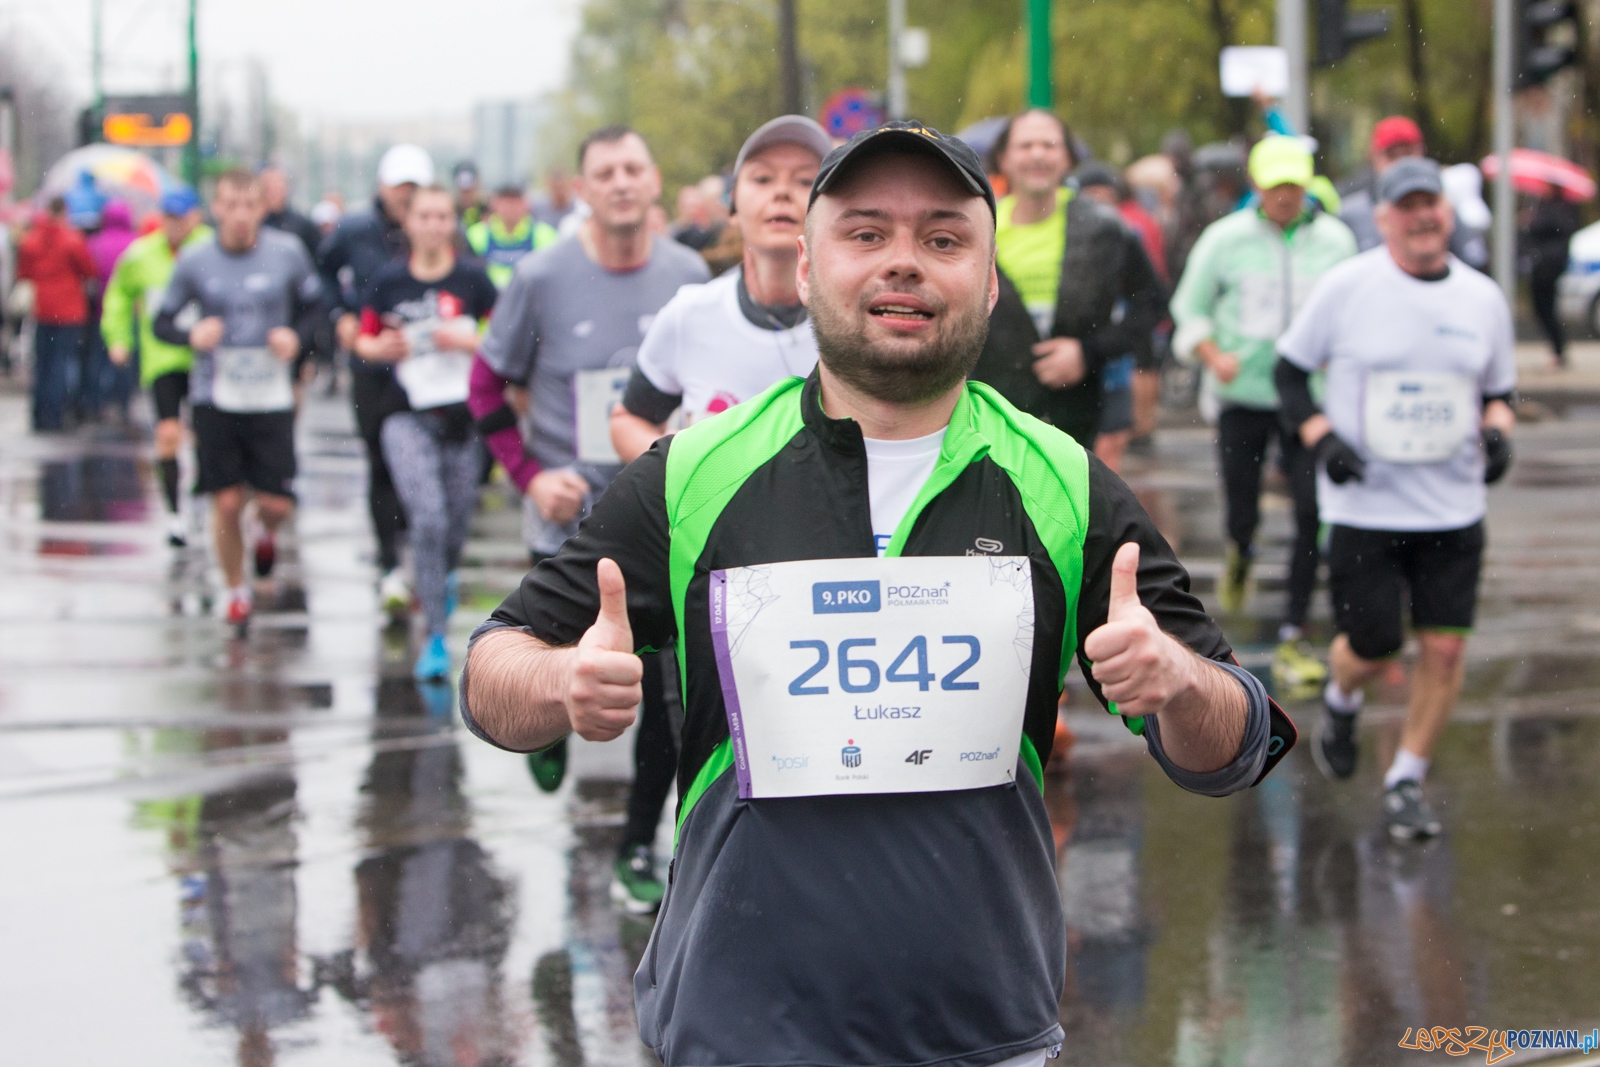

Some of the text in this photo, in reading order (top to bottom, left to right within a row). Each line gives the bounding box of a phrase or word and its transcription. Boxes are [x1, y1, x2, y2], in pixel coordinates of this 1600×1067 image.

[837, 589, 872, 605] PKO
[788, 635, 981, 696] 2642
[854, 704, 922, 720] Łukasz
[904, 749, 933, 766] 4F
